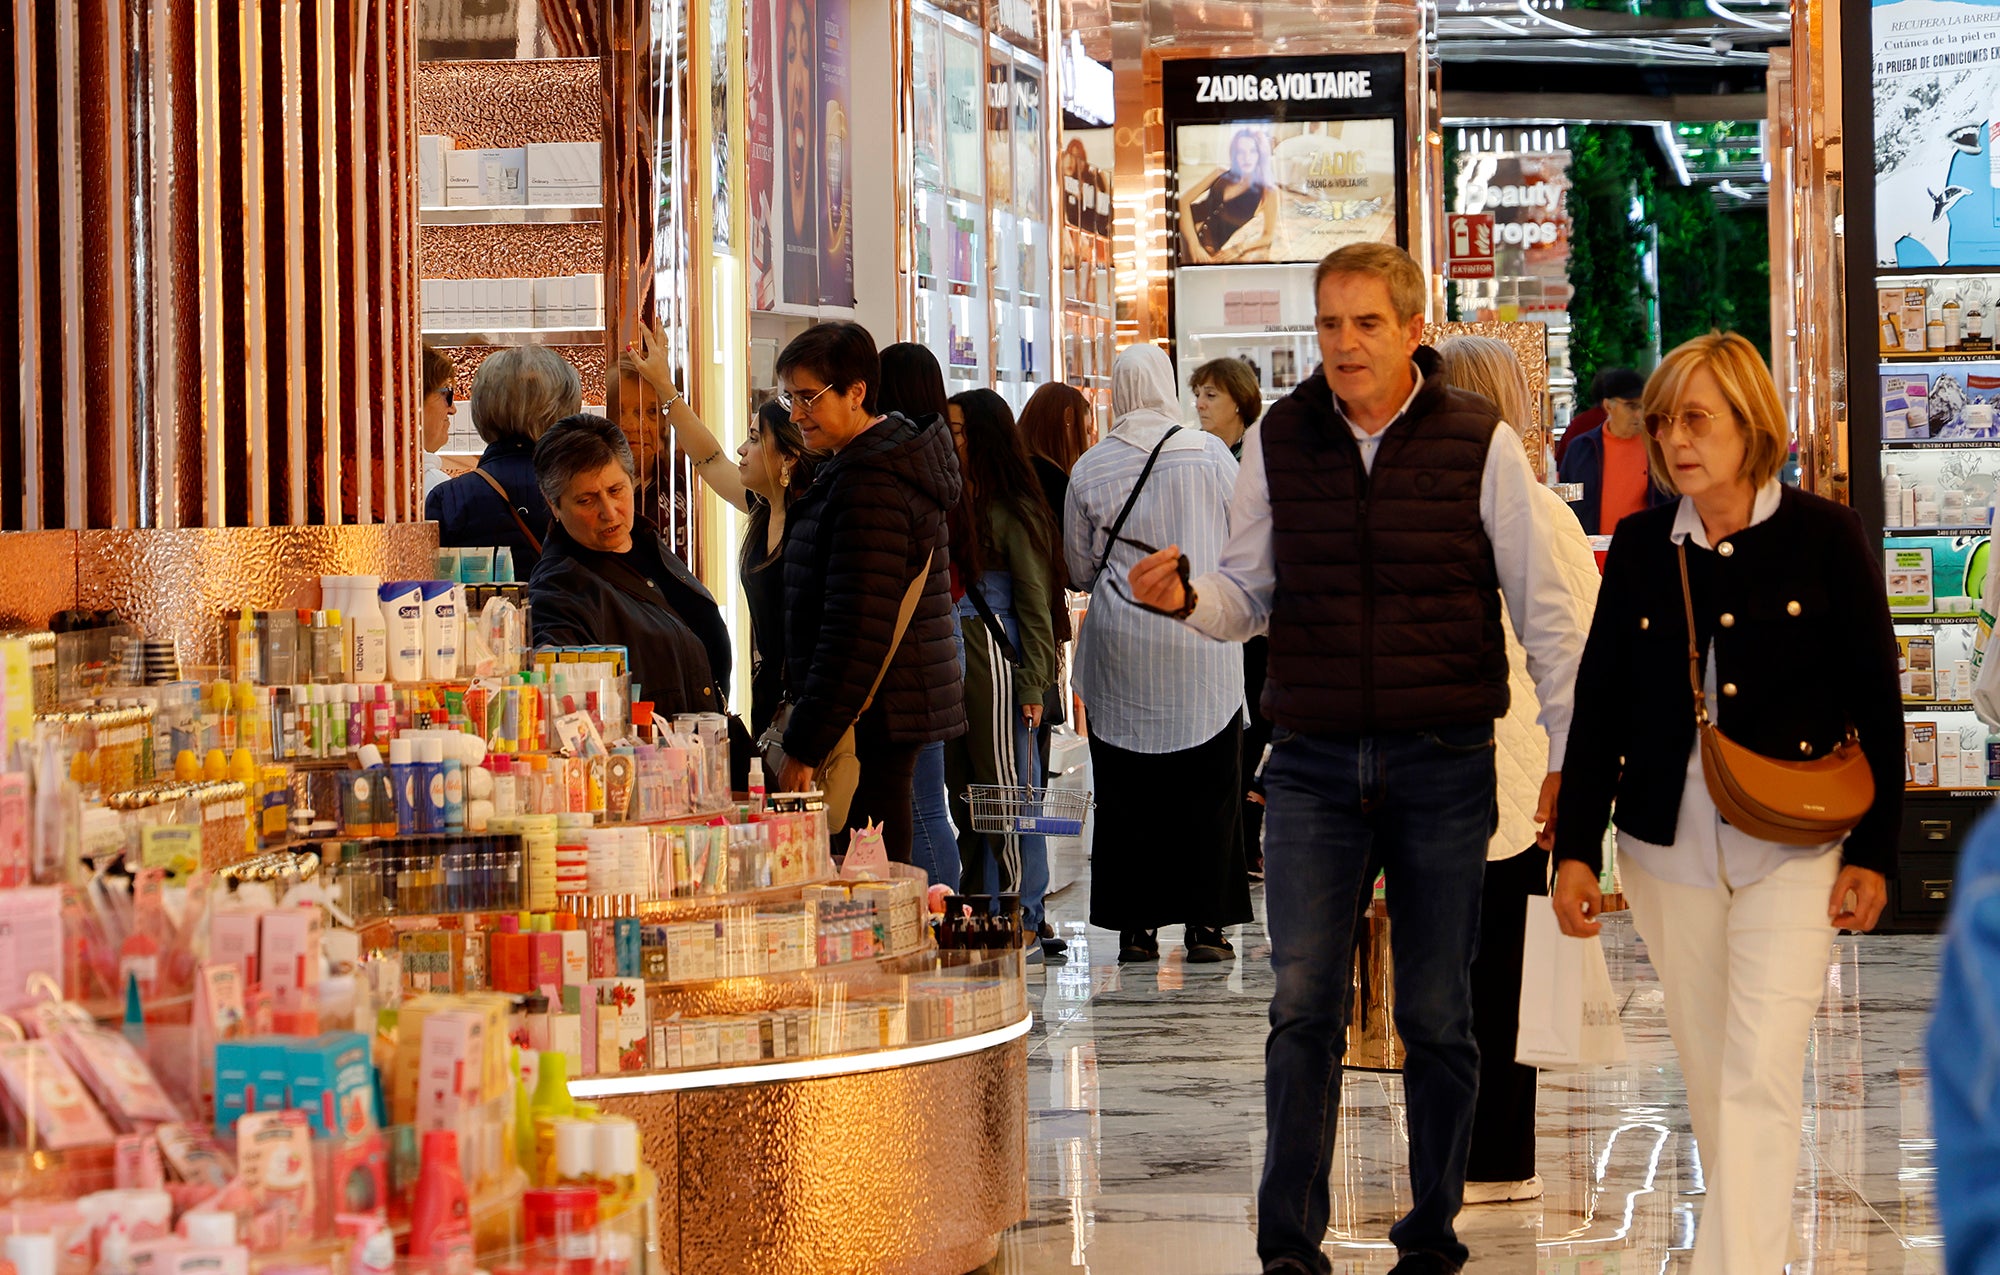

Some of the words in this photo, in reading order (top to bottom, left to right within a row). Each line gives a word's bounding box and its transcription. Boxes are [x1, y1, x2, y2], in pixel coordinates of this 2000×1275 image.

[1891, 18, 1945, 31] RECUPERA
[1948, 16, 1961, 25] LA
[1884, 38, 1929, 50] Cutánea
[1932, 36, 1945, 45] de
[1948, 34, 1957, 43] la
[1961, 31, 1980, 44] piel
[1983, 31, 1996, 39] en
[1877, 62, 1884, 75] A
[1886, 58, 1918, 73] PRUEBA
[1920, 56, 1930, 69] DE
[1933, 48, 1988, 68] CONDICIONES
[1308, 150, 1367, 176] ZADIG
[1494, 222, 1558, 250] rops
[1451, 264, 1493, 275] EXTINTOR
